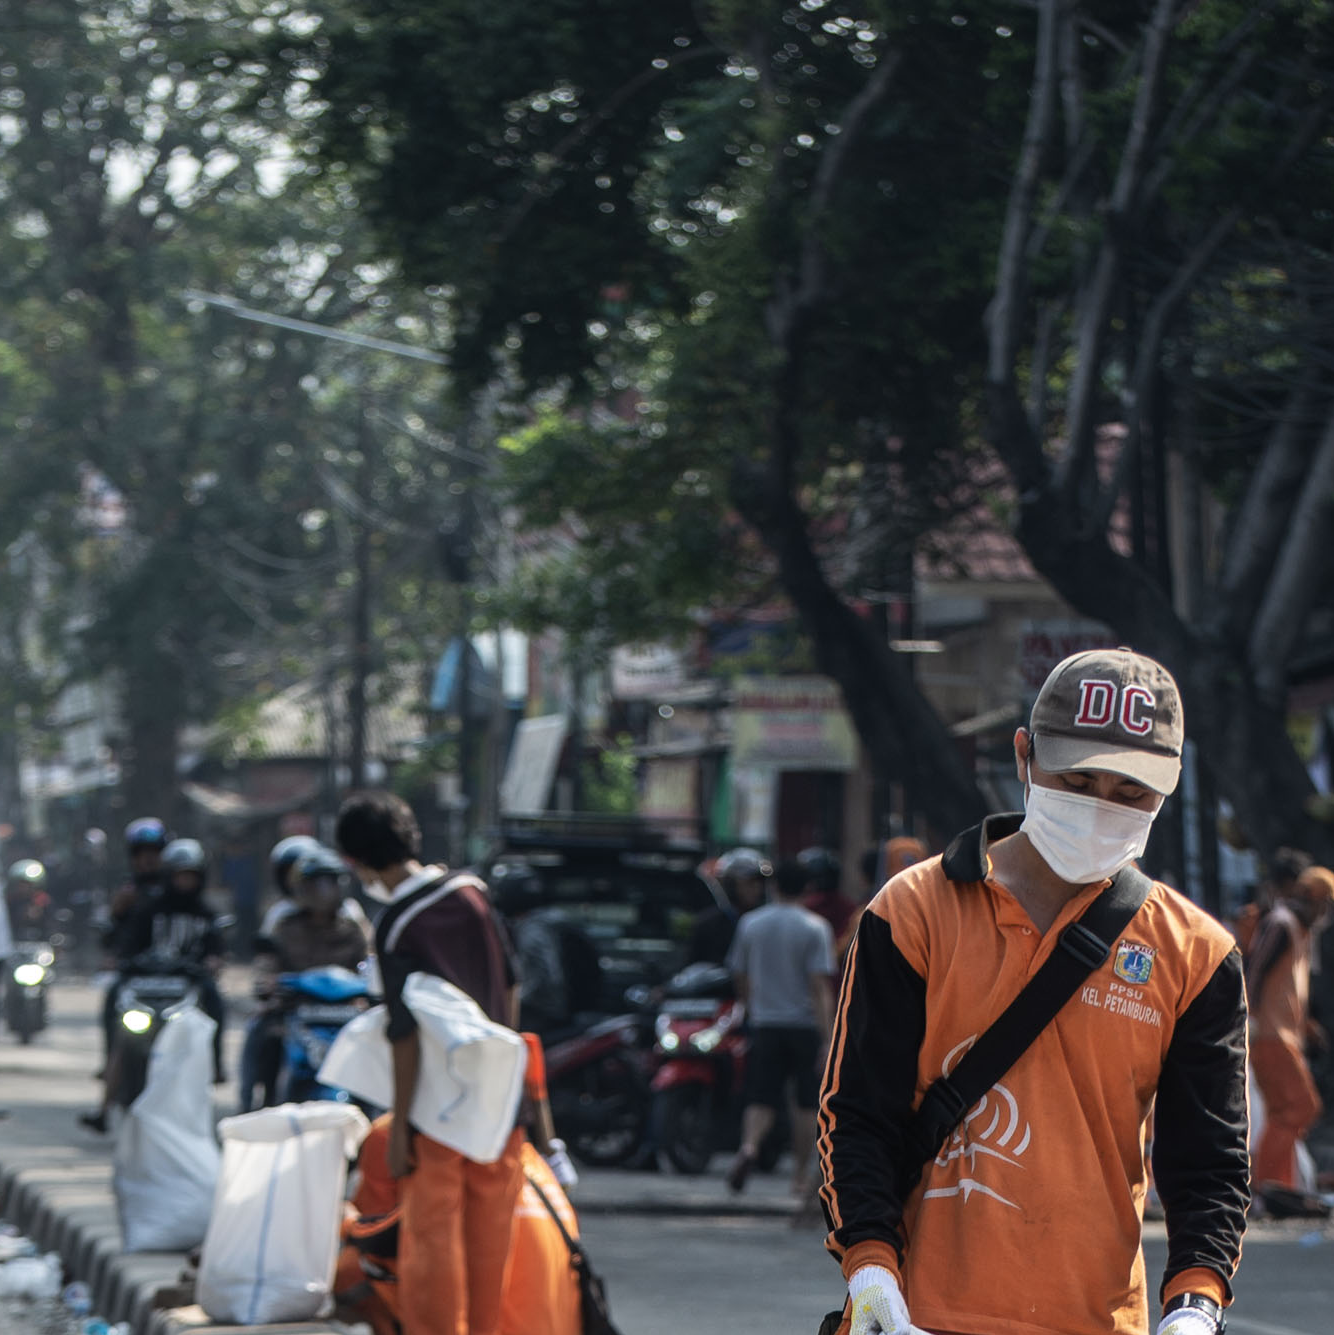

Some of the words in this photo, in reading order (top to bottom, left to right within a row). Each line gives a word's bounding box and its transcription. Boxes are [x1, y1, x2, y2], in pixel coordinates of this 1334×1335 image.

[1075, 679, 1156, 736] DC
[1081, 986, 1101, 1007] KEL.
[1104, 993, 1162, 1027] PETAMBURAN
[1110, 982, 1144, 1001] PPSU
